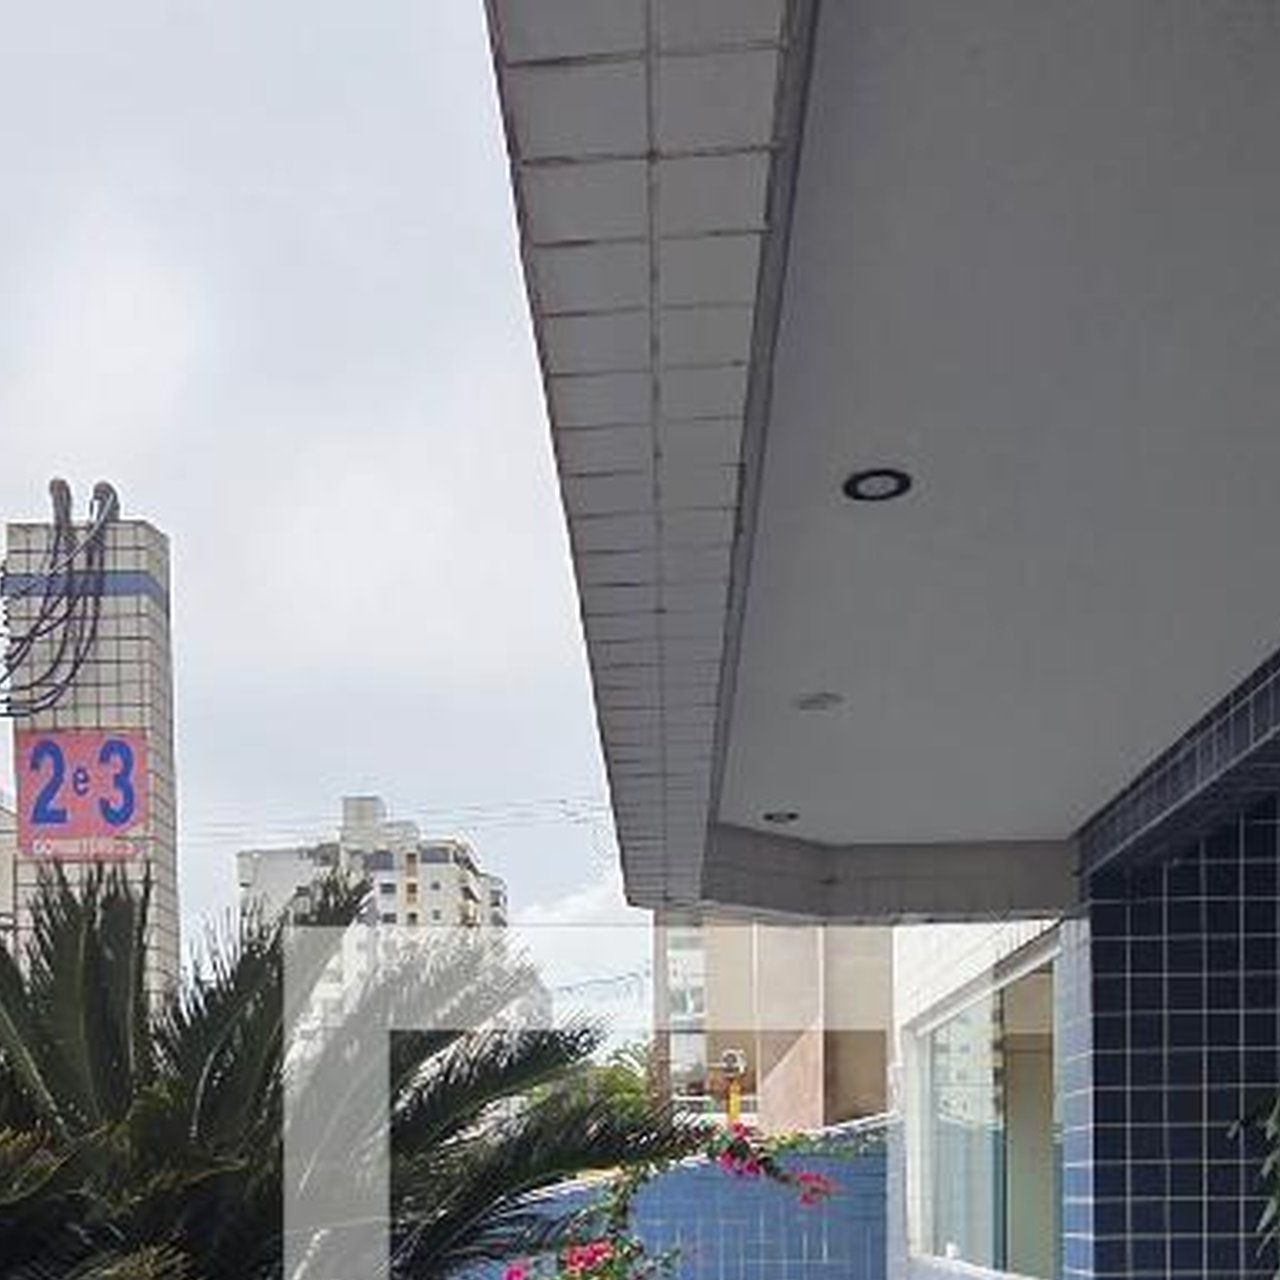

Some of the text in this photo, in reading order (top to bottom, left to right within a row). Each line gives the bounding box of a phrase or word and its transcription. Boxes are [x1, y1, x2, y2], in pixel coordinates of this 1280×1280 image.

[30, 738, 135, 826] 2 e 3
